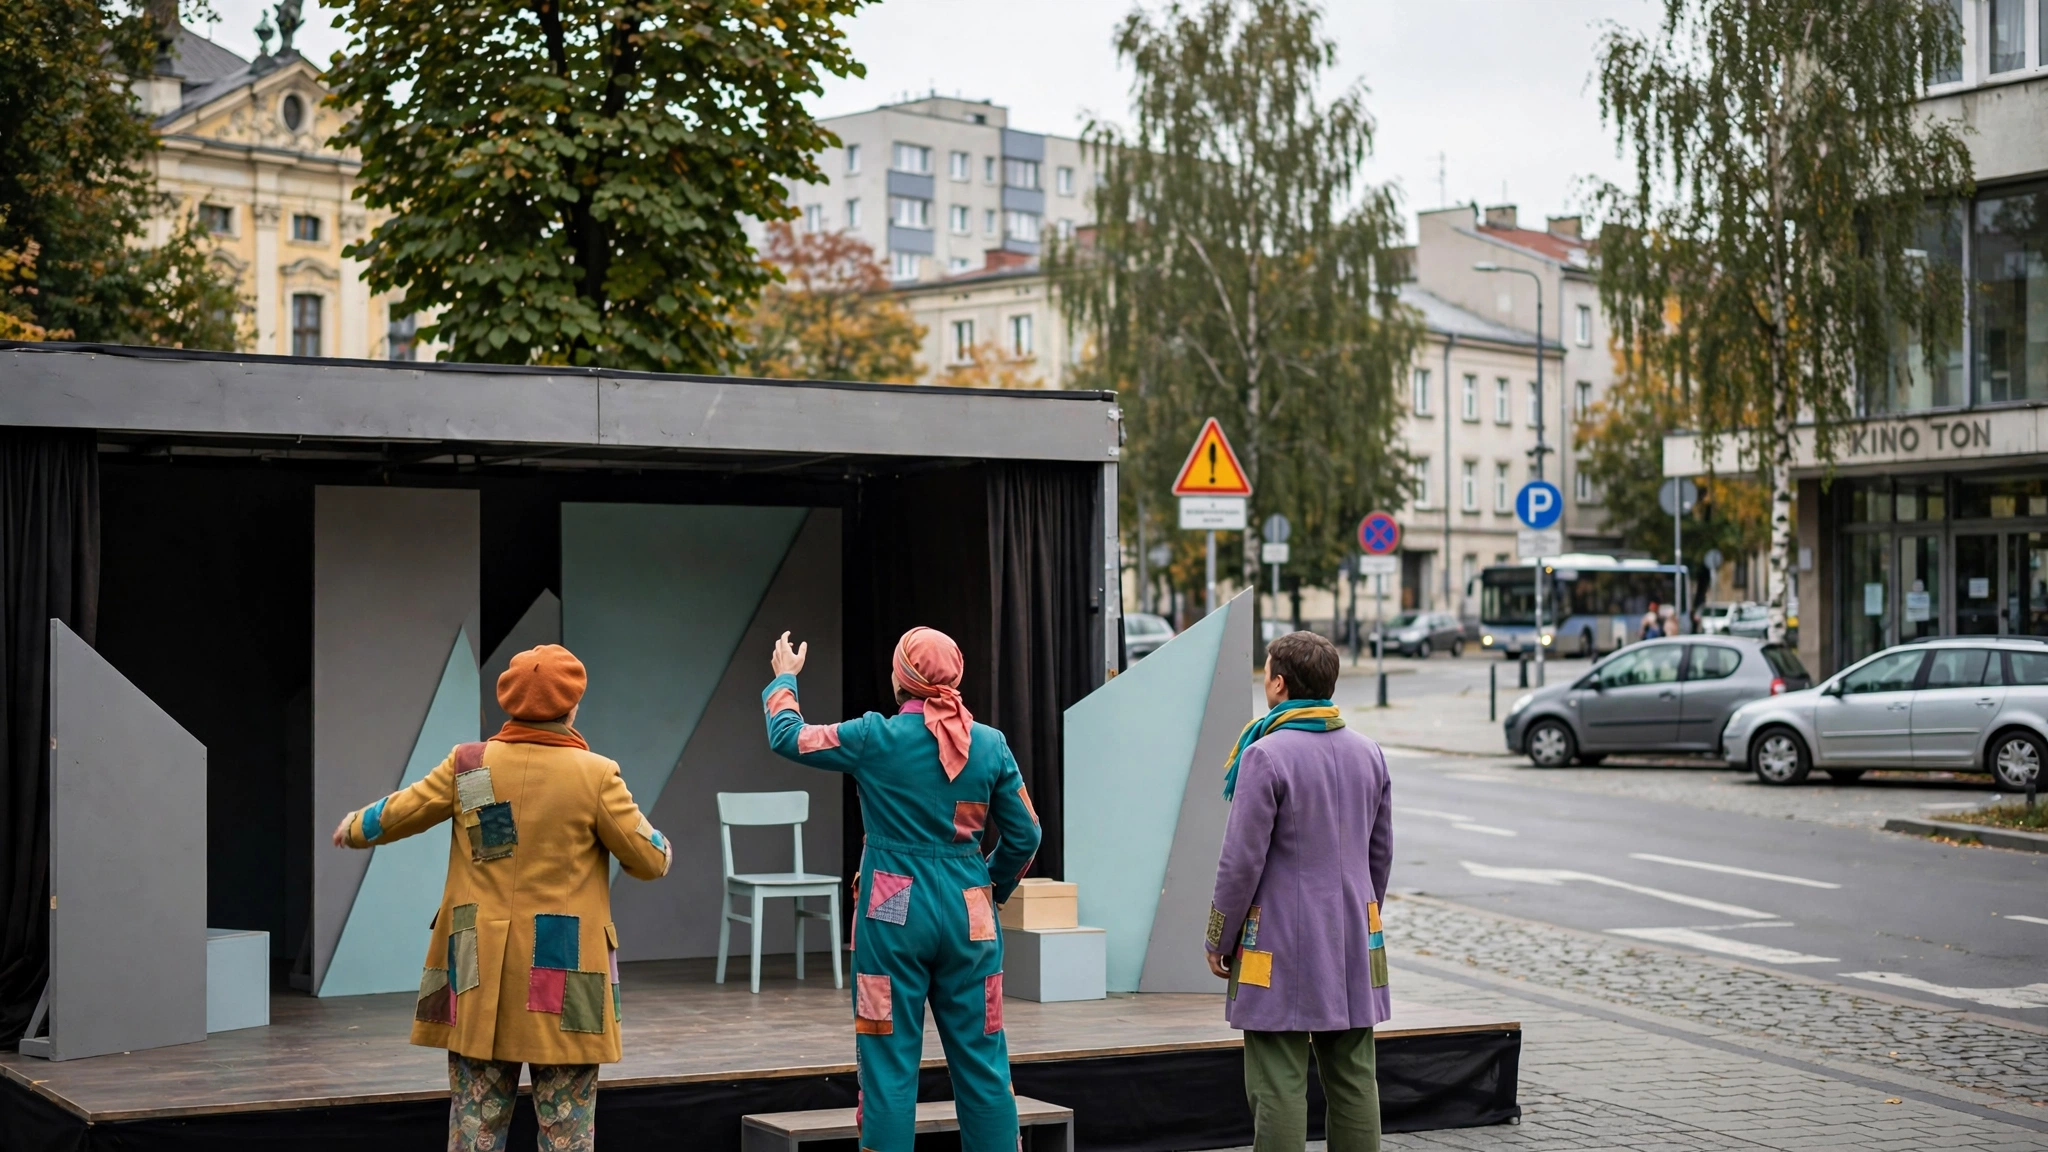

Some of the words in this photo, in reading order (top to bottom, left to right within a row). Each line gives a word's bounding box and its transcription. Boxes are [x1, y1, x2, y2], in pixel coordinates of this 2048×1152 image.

[1852, 426, 1919, 455] KINO
[1930, 419, 1991, 450] TON
[1528, 487, 1553, 523] P
